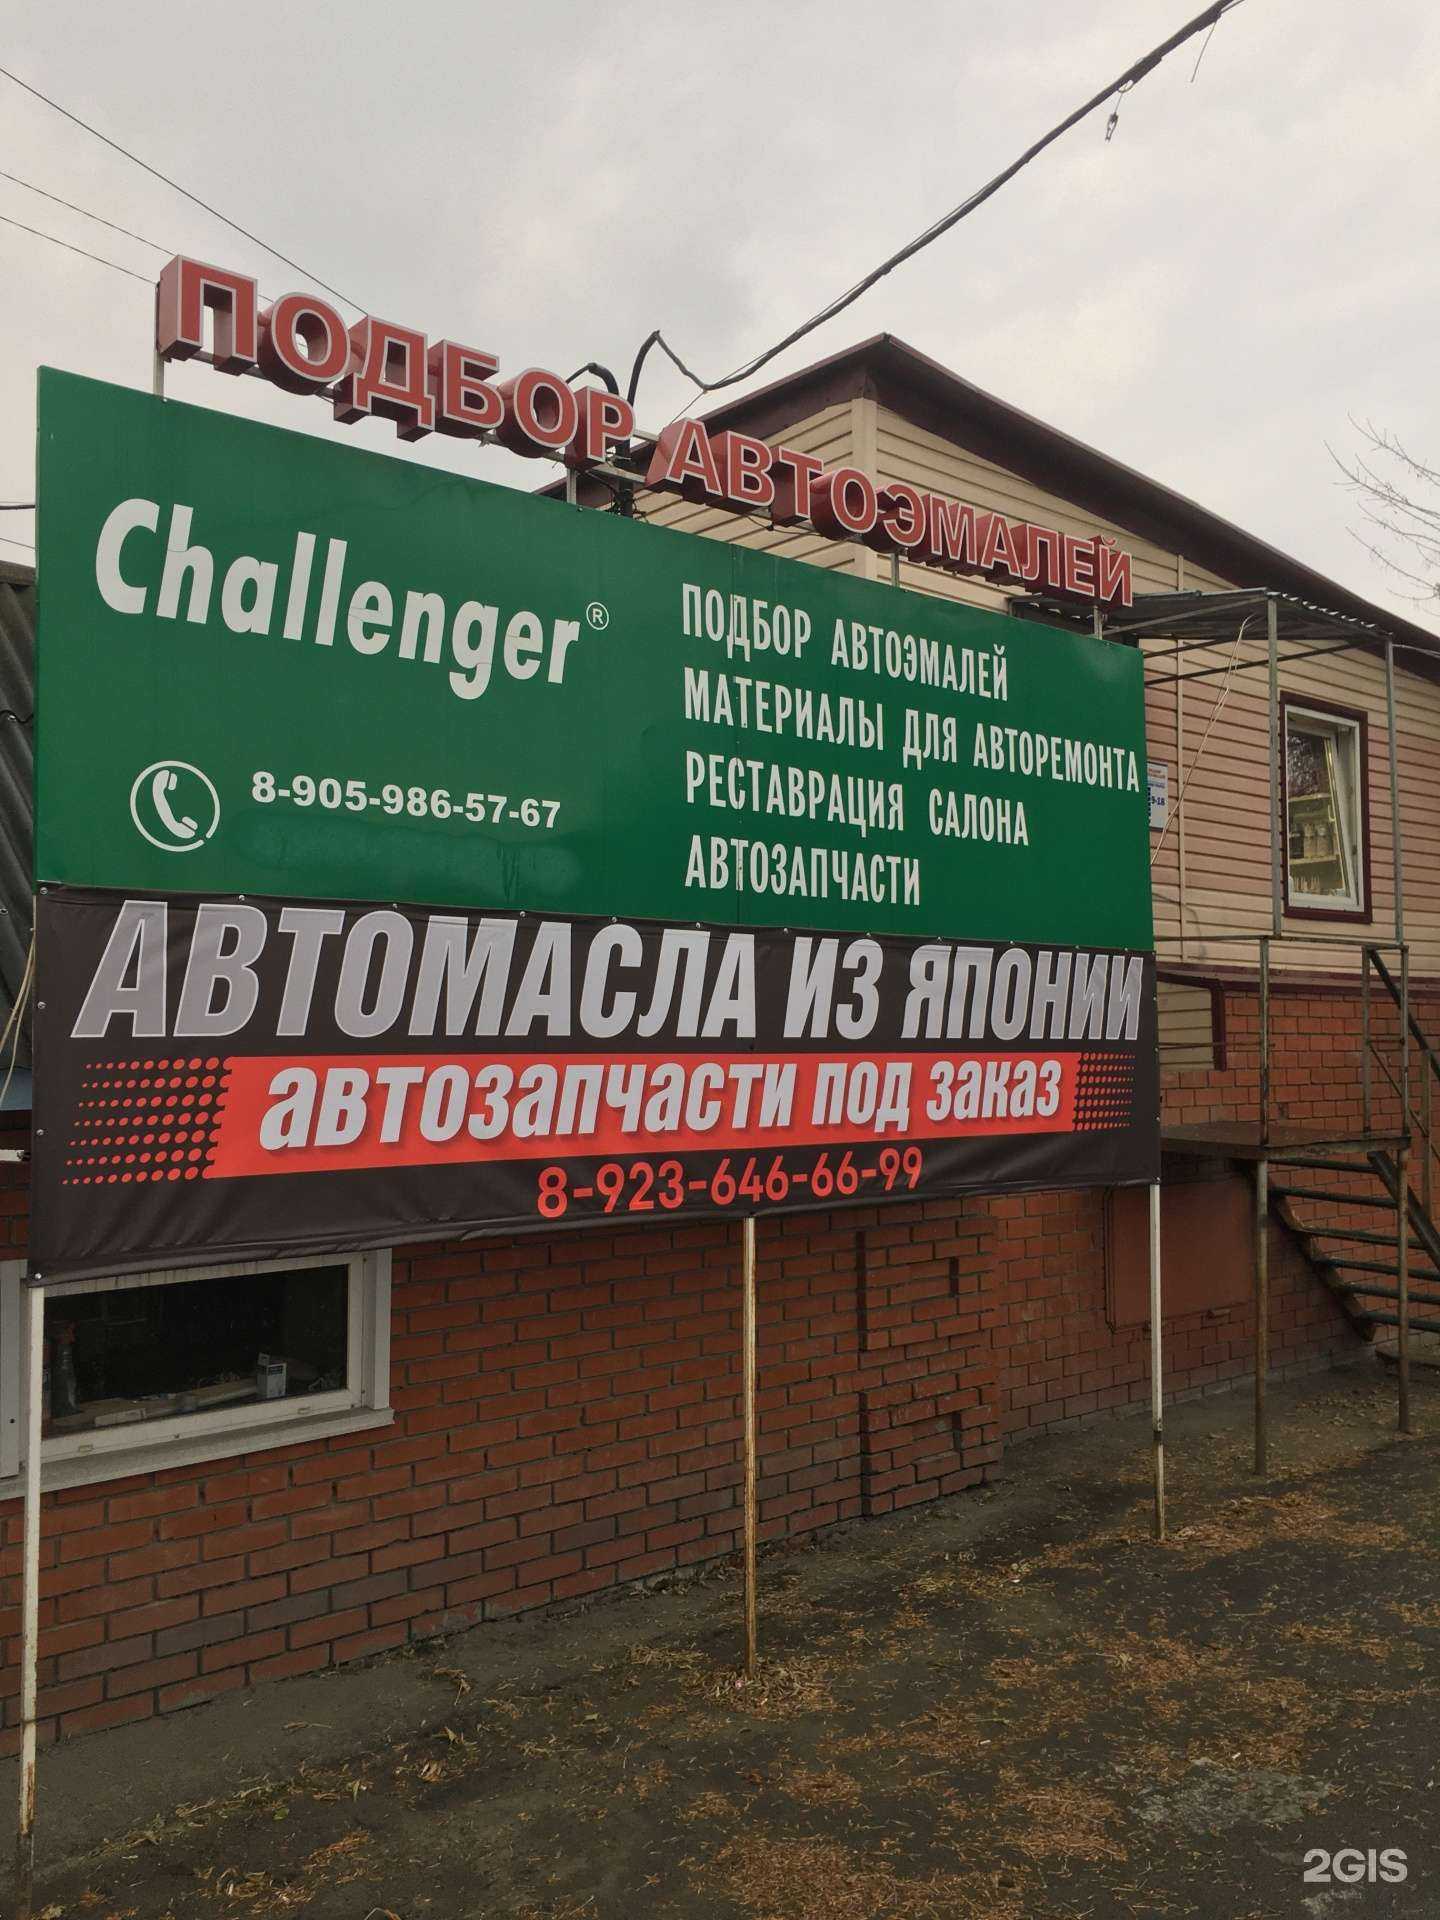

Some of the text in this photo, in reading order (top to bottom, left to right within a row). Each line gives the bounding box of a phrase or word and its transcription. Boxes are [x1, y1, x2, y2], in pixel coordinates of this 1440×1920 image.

[161, 254, 1133, 607] ПОДБОР АВТОЭМАЛЕЙ
[96, 497, 580, 700] Challenger
[683, 583, 1008, 702] ПОДБОР АВТОЭМАЛЕЙ
[684, 667, 1140, 793] МАТЕРИАЛЫ ДЛЯ АВТОРЕМОНТА
[252, 771, 561, 829] 8-905-986-57-67
[687, 751, 1029, 846] РЕСТАВРАЦИЯ САЛОНА
[685, 835, 920, 906] АВТОЗАПЧАСТИ
[70, 900, 1144, 1041] АВТОМАСЛА ИЗ ЯПОНИИ
[259, 1060, 1062, 1151] автозапчасти под заказ
[537, 1147, 922, 1218] 8-923-646-66-99
